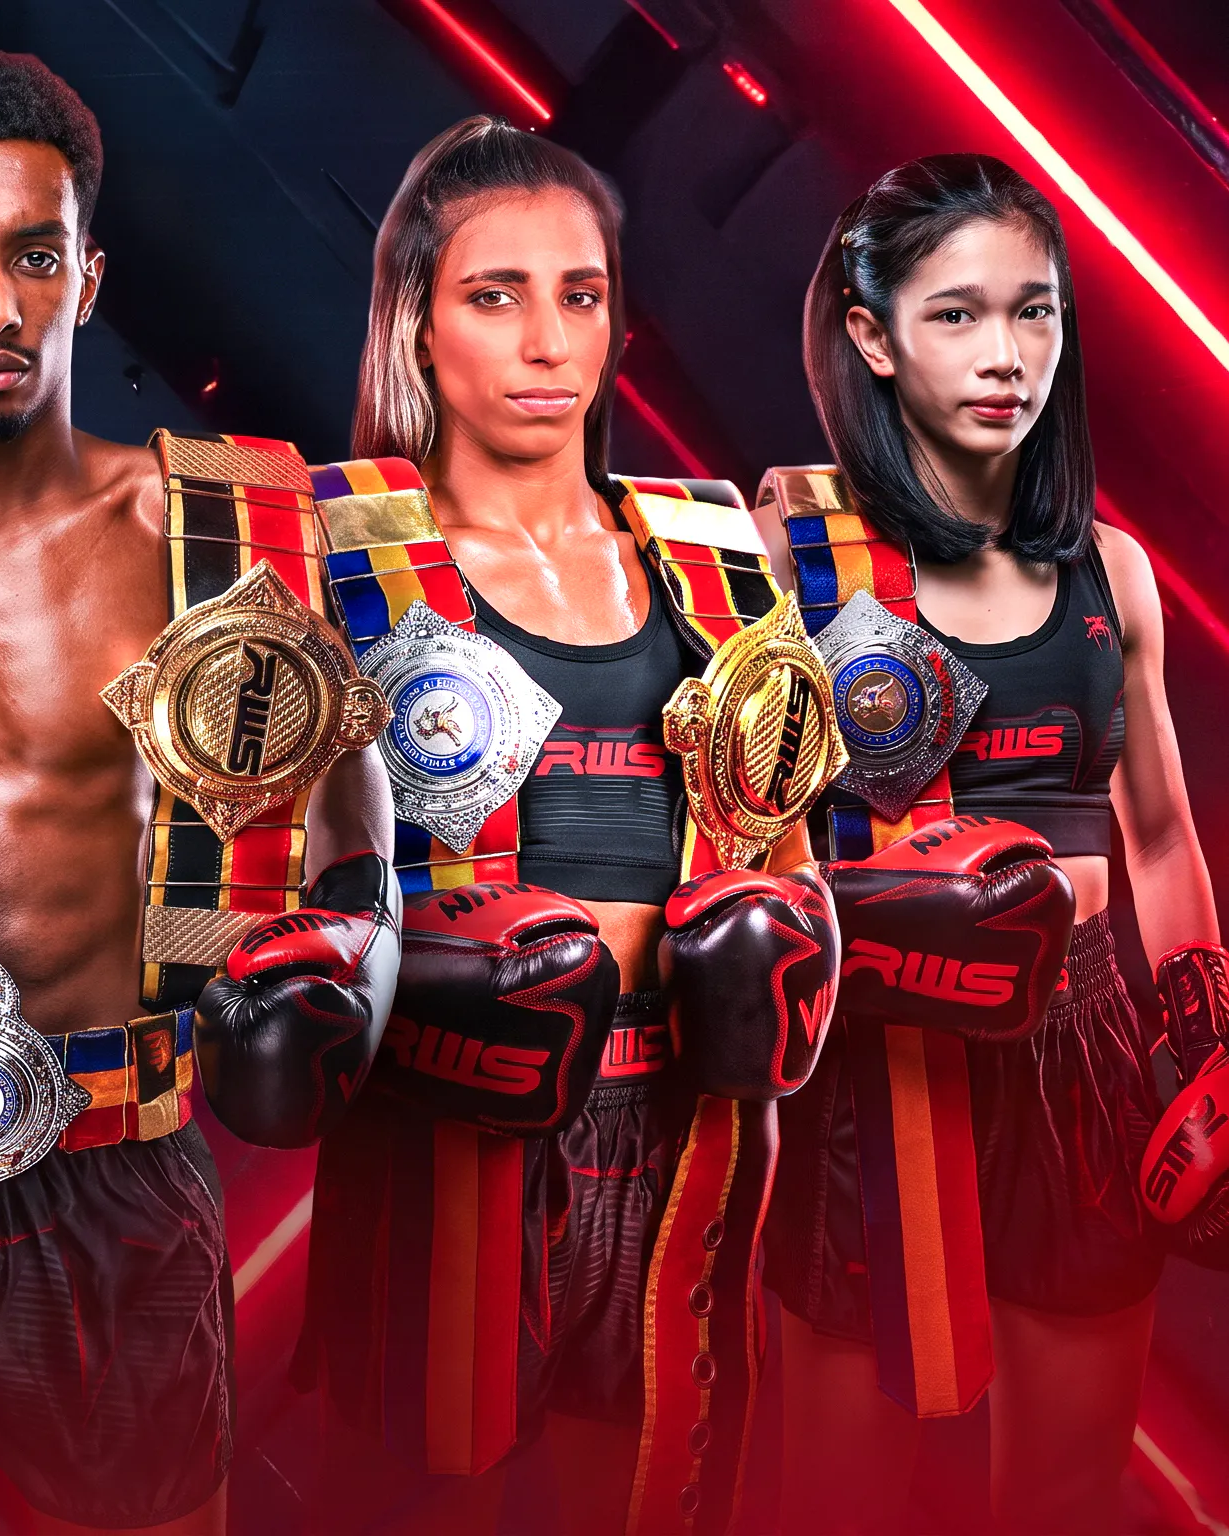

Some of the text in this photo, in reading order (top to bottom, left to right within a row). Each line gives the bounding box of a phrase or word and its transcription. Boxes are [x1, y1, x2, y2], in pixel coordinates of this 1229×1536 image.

[226, 639, 278, 776] RWS
[534, 741, 666, 778] RWS
[957, 725, 1065, 761] RWS
[842, 938, 1020, 1007] RWS
[381, 1012, 551, 1095] RWS
